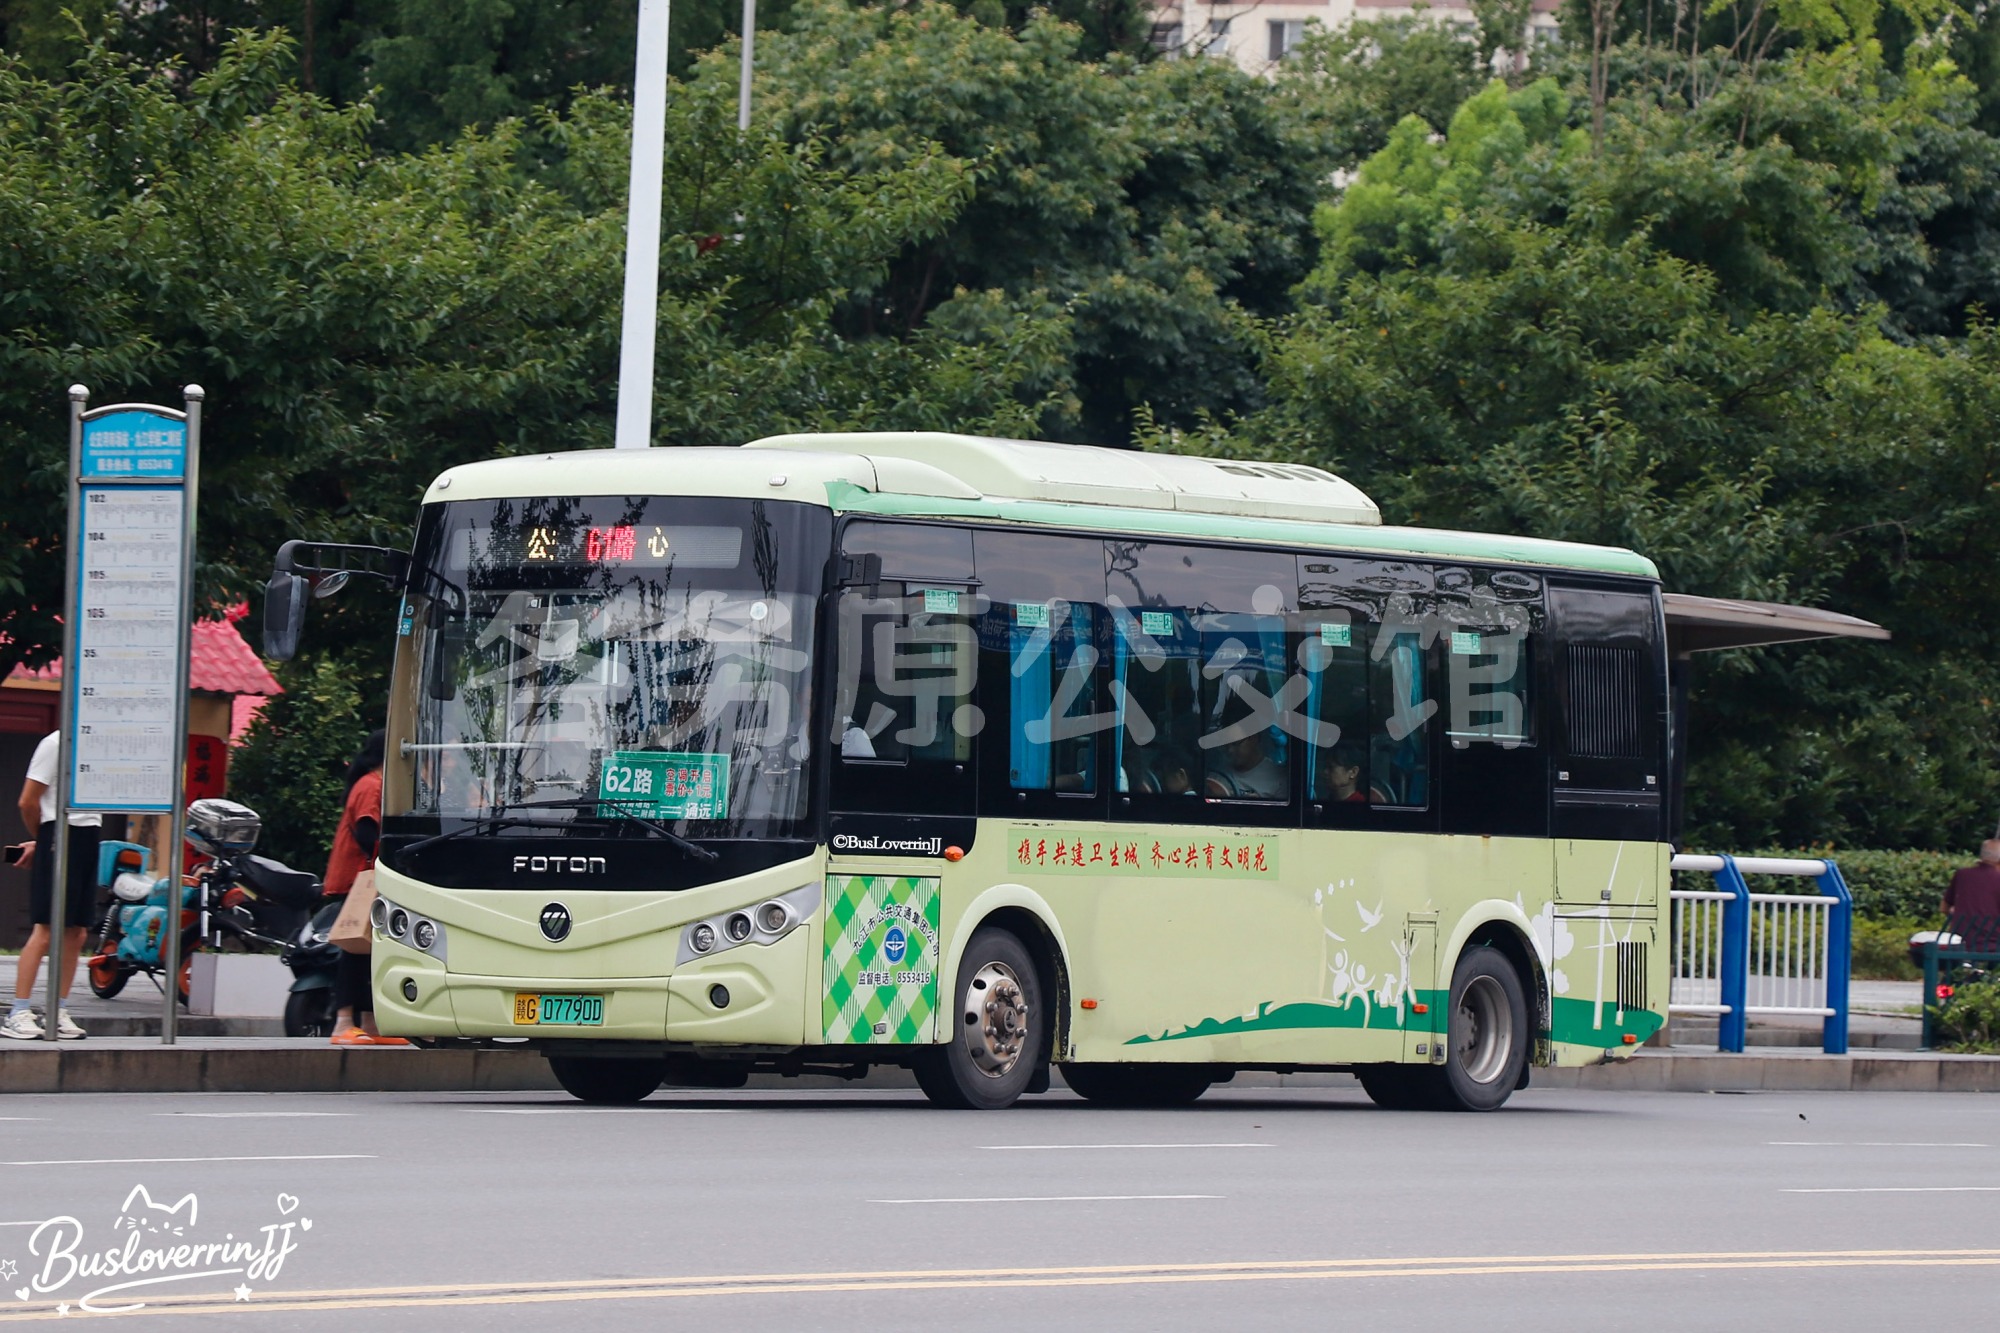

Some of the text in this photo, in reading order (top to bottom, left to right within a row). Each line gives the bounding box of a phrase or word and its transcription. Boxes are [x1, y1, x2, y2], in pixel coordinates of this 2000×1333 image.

[605, 766, 653, 795] 62路
[665, 768, 712, 784] 空调开启
[513, 855, 606, 874] FOTON
[1017, 837, 1269, 872] 携手共建卫生城 齐心共育文明花
[853, 904, 939, 957] 九江市公共交通集团公司
